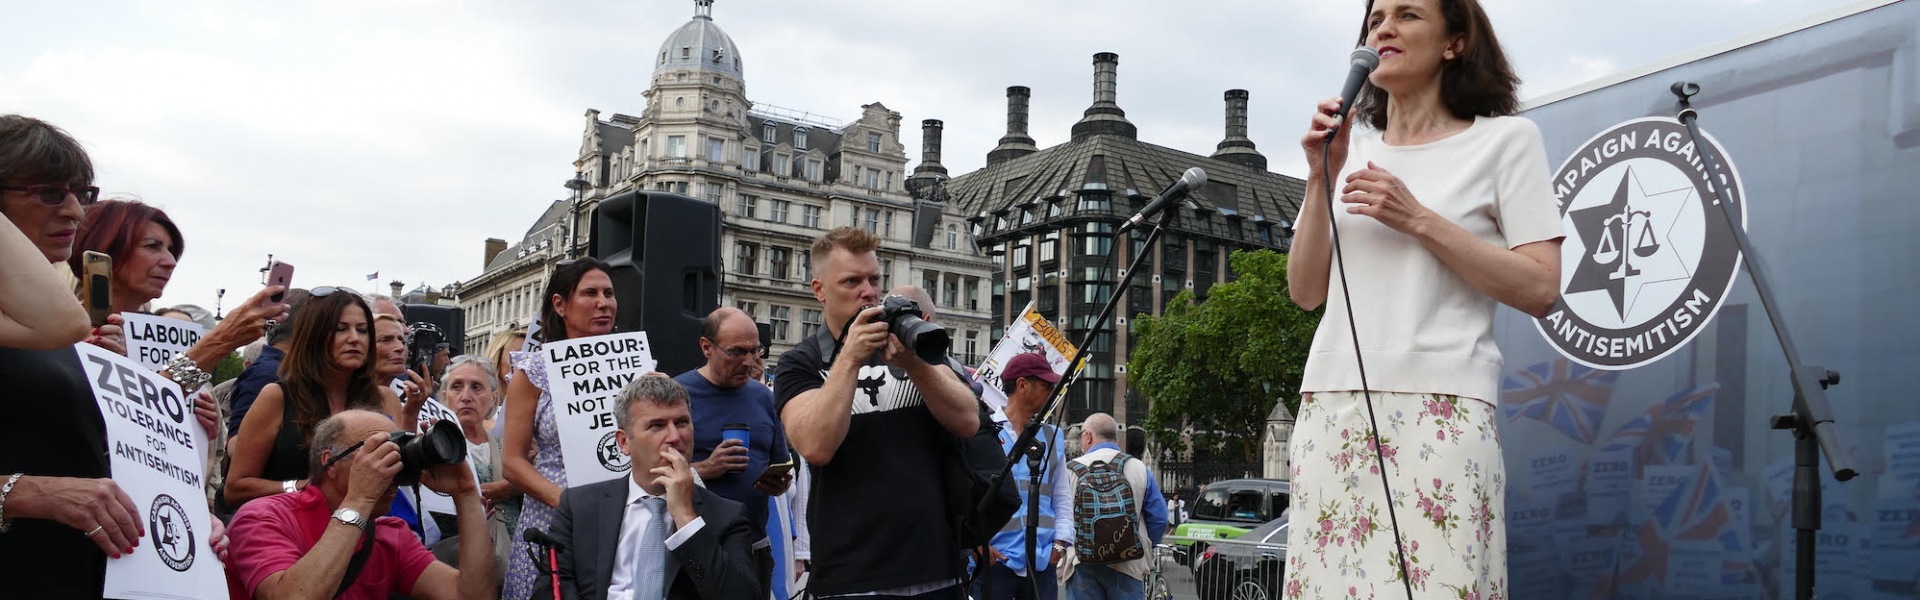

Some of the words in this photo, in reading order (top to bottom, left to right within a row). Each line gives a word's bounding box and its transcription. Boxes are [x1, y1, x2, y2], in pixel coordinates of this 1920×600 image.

[1554, 130, 1637, 209] MPAIGN
[1031, 317, 1070, 354] BORIS
[1546, 288, 1711, 358] ANTISEMITISM
[140, 346, 170, 364] FOR
[550, 338, 645, 363] LABOUR:
[561, 361, 600, 379] FOR
[606, 355, 642, 370] THE
[87, 353, 185, 424] ZERO
[567, 397, 607, 416] NOT
[589, 412, 616, 430] JE
[101, 395, 194, 450] TOLERANCE
[145, 434, 168, 456] FOR
[115, 440, 201, 489] ANTISEMITISM
